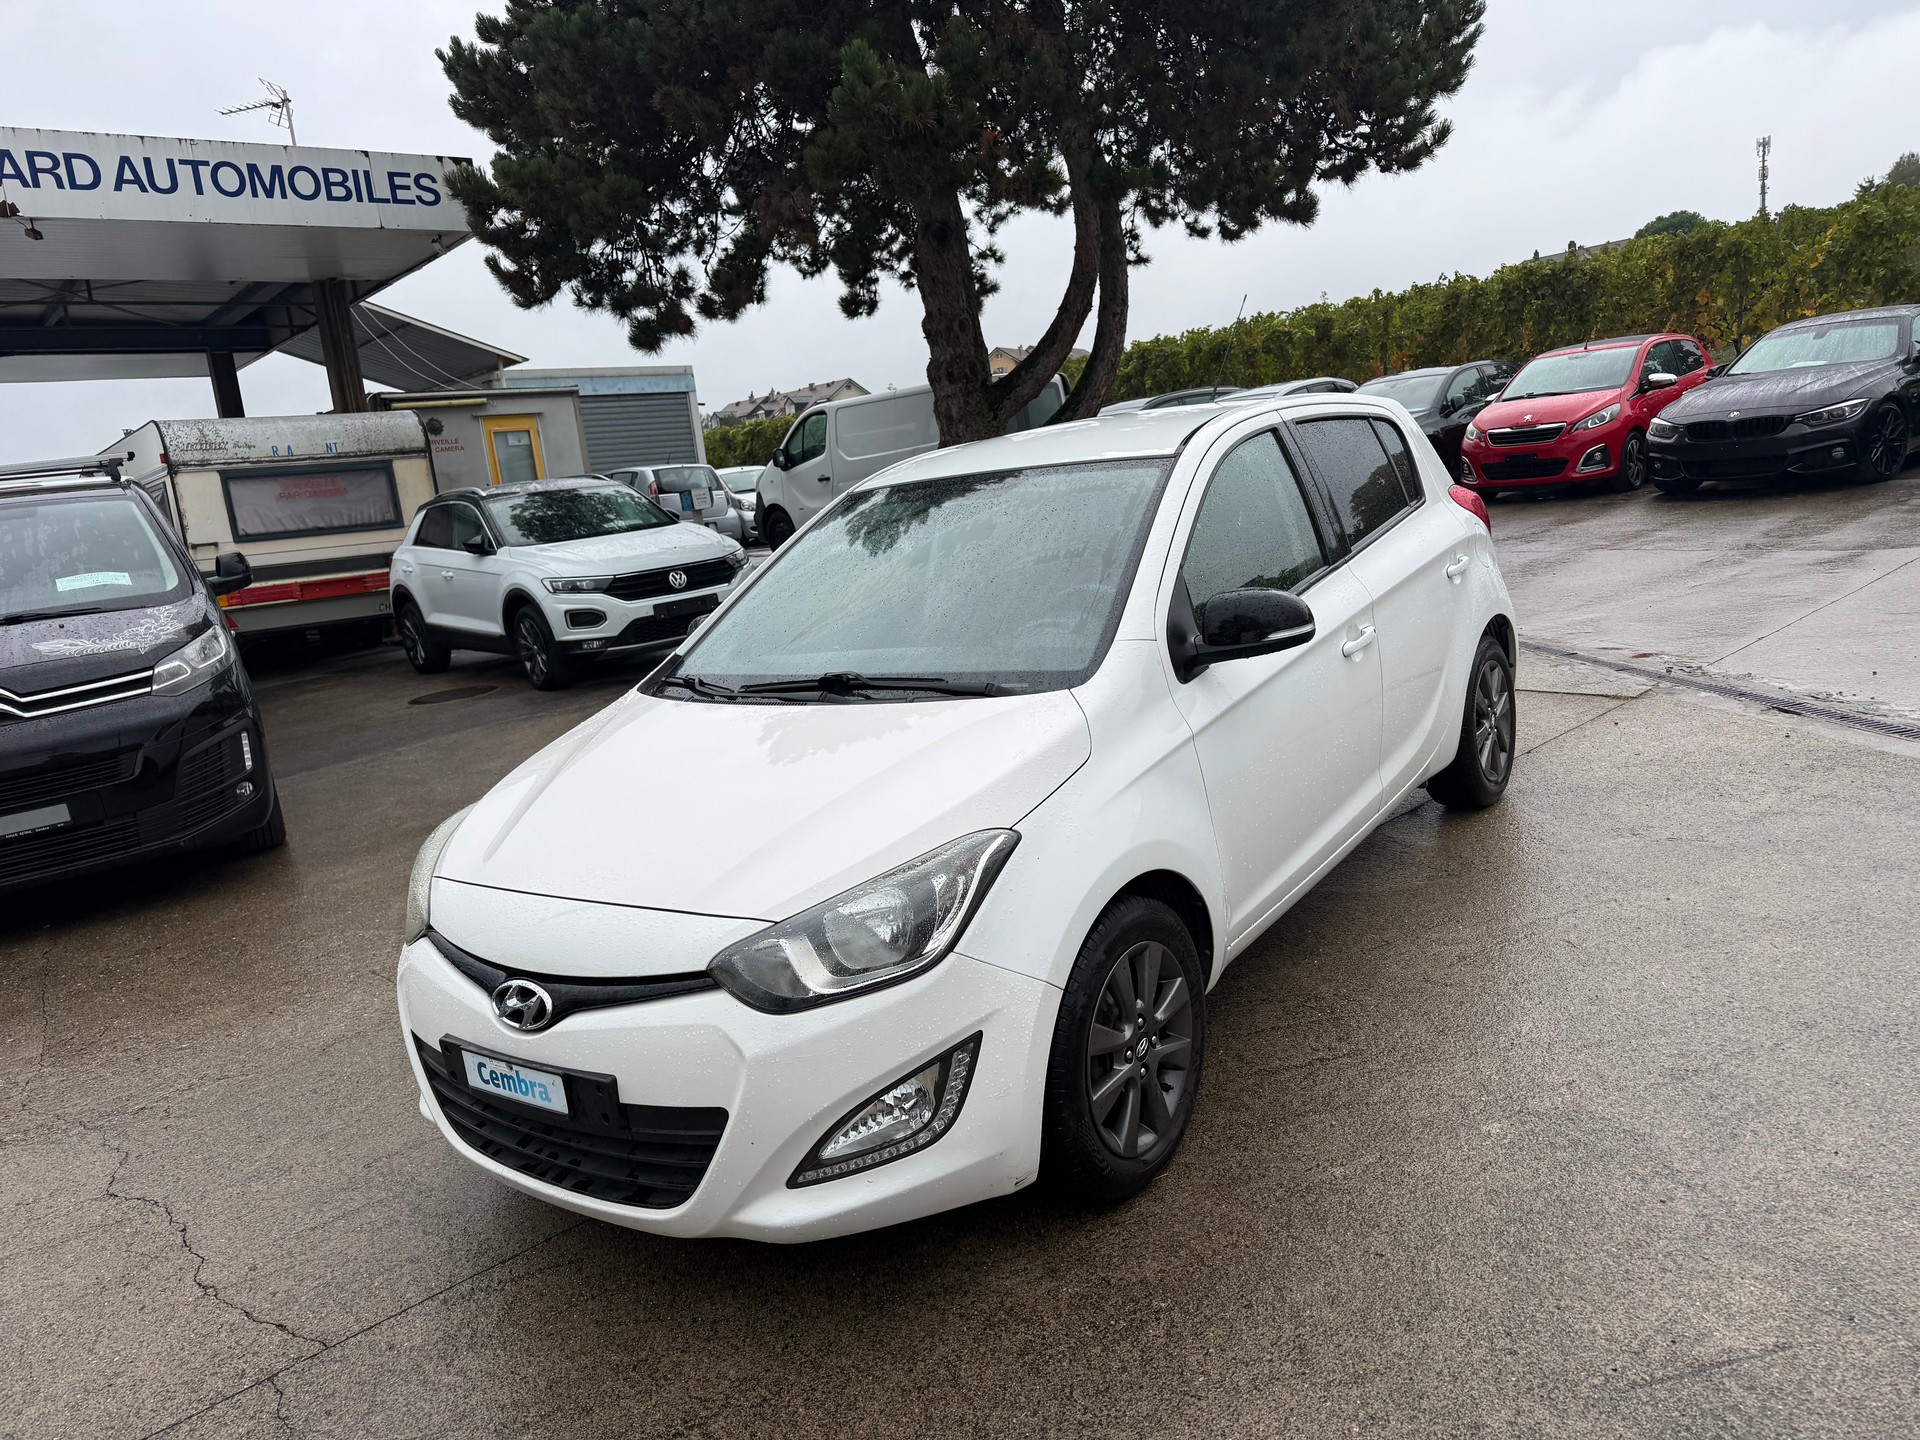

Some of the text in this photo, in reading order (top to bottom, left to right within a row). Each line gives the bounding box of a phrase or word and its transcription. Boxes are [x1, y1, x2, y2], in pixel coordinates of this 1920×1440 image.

[0, 148, 442, 207] ARD AUTOMOBILES
[435, 445, 465, 453] CAMERA
[477, 1062, 552, 1103] Cembra
